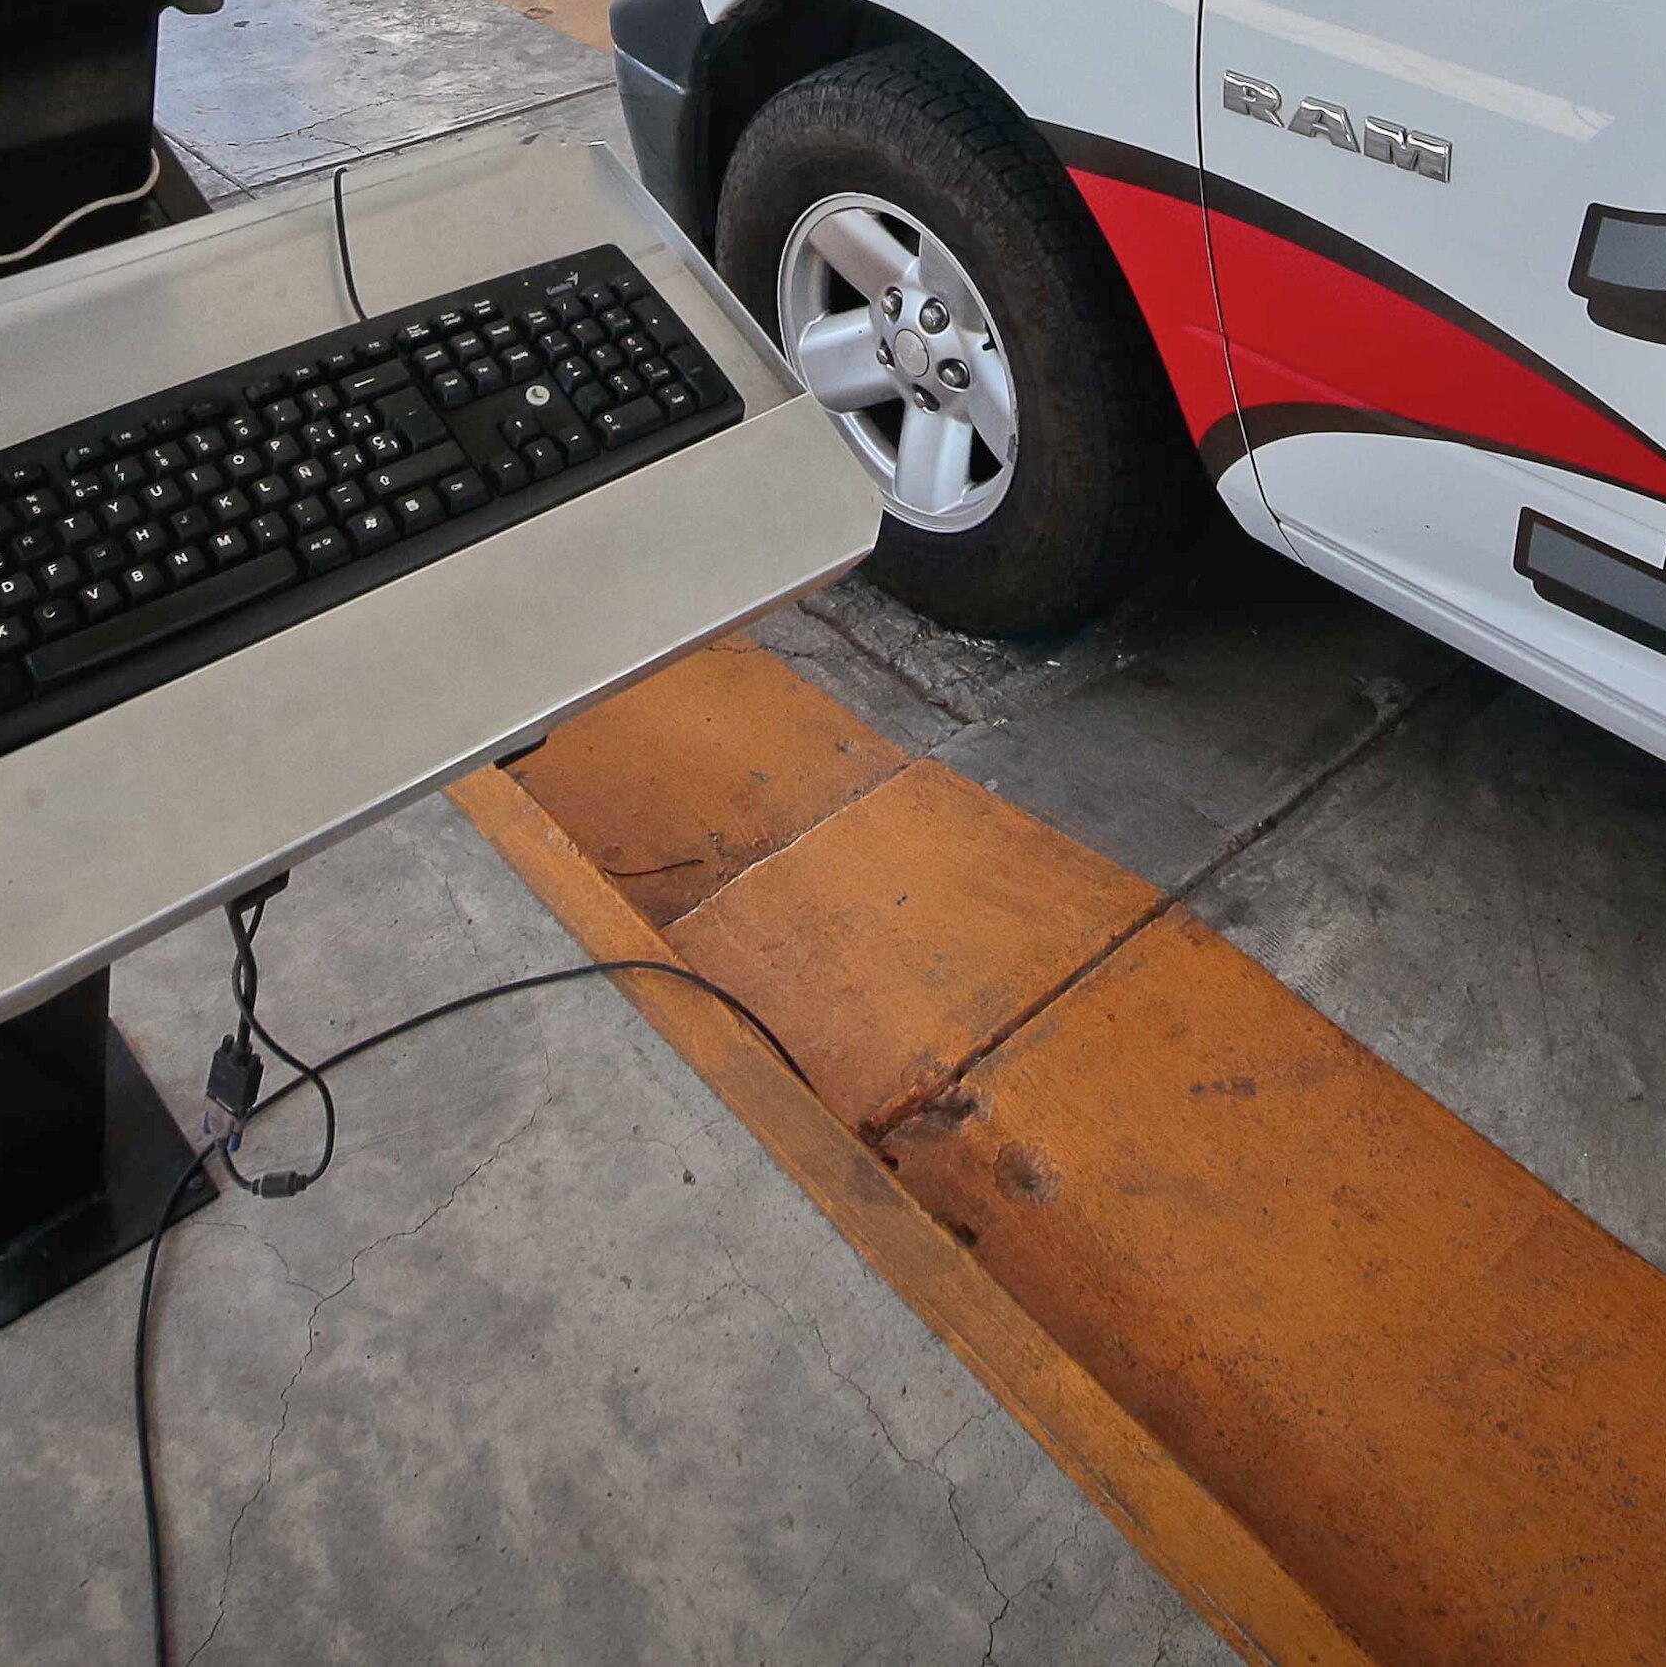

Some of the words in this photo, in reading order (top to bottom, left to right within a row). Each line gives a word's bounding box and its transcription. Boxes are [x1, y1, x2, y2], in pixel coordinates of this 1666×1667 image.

[1223, 69, 1452, 183] RAM
[149, 485, 162, 497] U
[107, 502, 118, 513] Y
[219, 496, 232, 508] K
[64, 518, 75, 529] T
[135, 529, 150, 541] H
[216, 534, 232, 547] M
[174, 552, 188, 565] N
[48, 564, 58, 575] F
[131, 570, 143, 582] B
[1, 581, 14, 593] D
[87, 588, 99, 599] V
